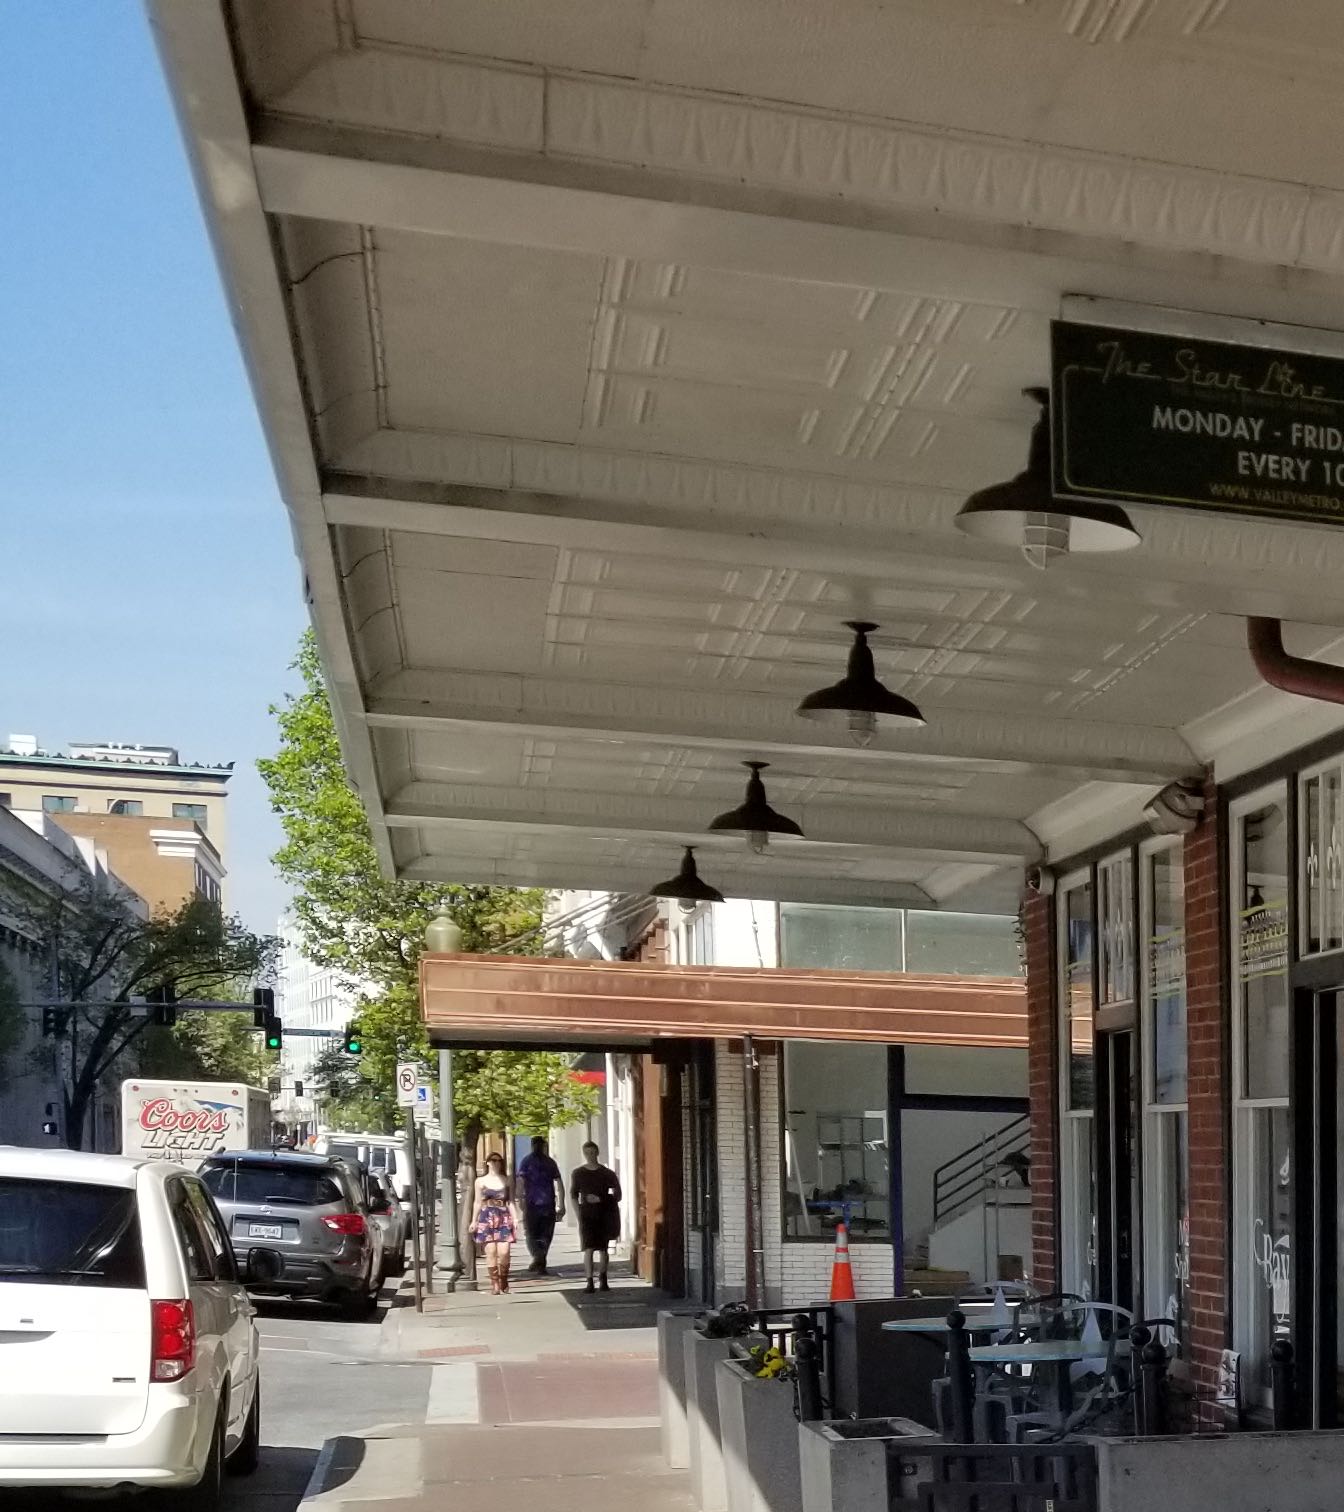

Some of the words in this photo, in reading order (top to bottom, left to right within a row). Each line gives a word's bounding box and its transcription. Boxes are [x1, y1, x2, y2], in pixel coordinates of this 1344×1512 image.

[1165, 349, 1252, 391] Star
[1152, 405, 1264, 441] MONDAY
[1237, 451, 1311, 482] EVERY
[140, 1098, 229, 1131] Coors
[141, 1130, 225, 1151] LIGHT
